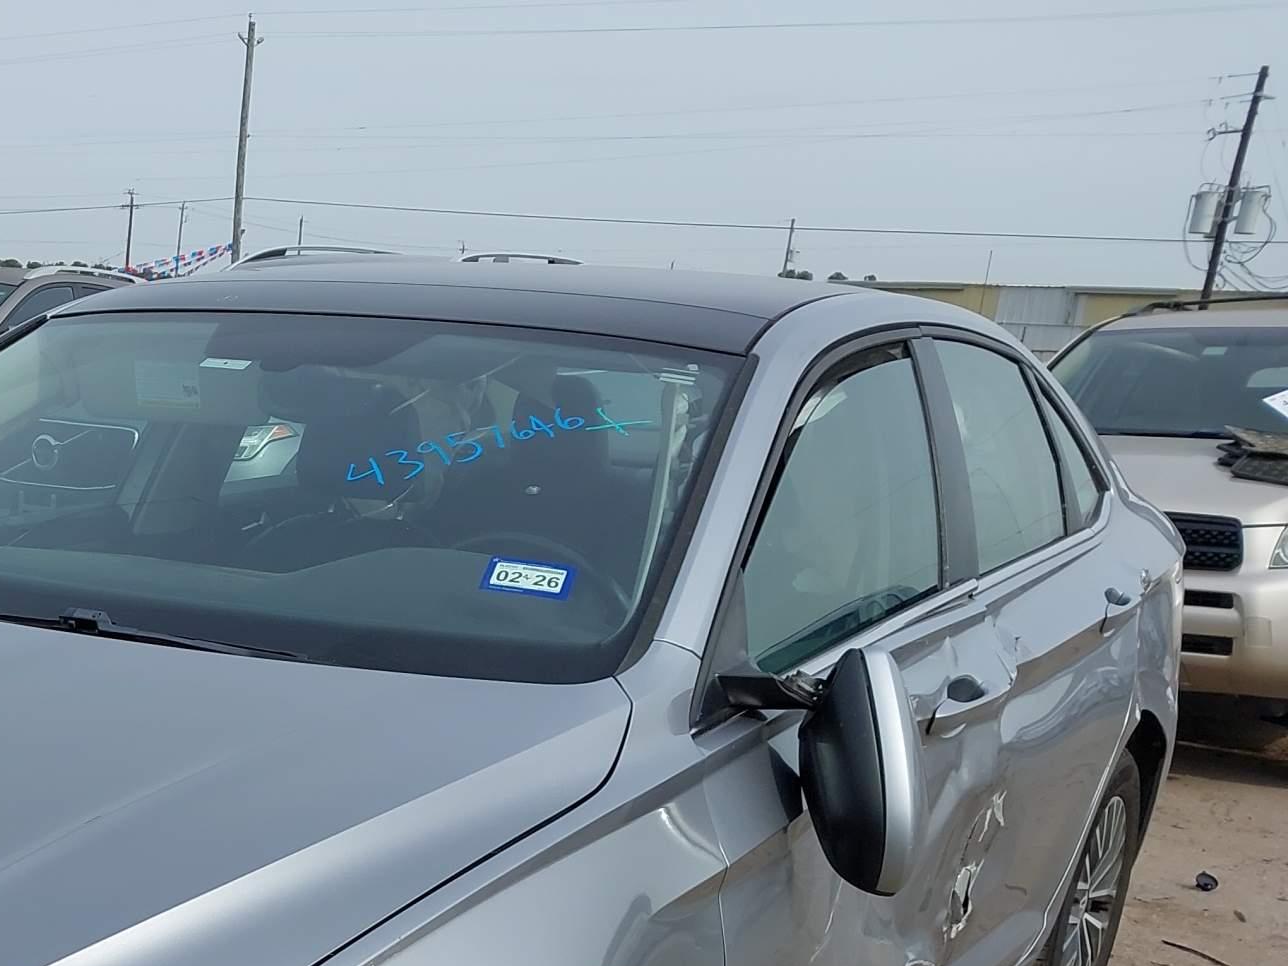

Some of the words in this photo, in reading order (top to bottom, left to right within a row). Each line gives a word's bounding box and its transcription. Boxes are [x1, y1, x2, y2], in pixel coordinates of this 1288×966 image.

[344, 407, 585, 486] 43957646
[496, 569, 523, 584] 02
[532, 574, 561, 589] 26
